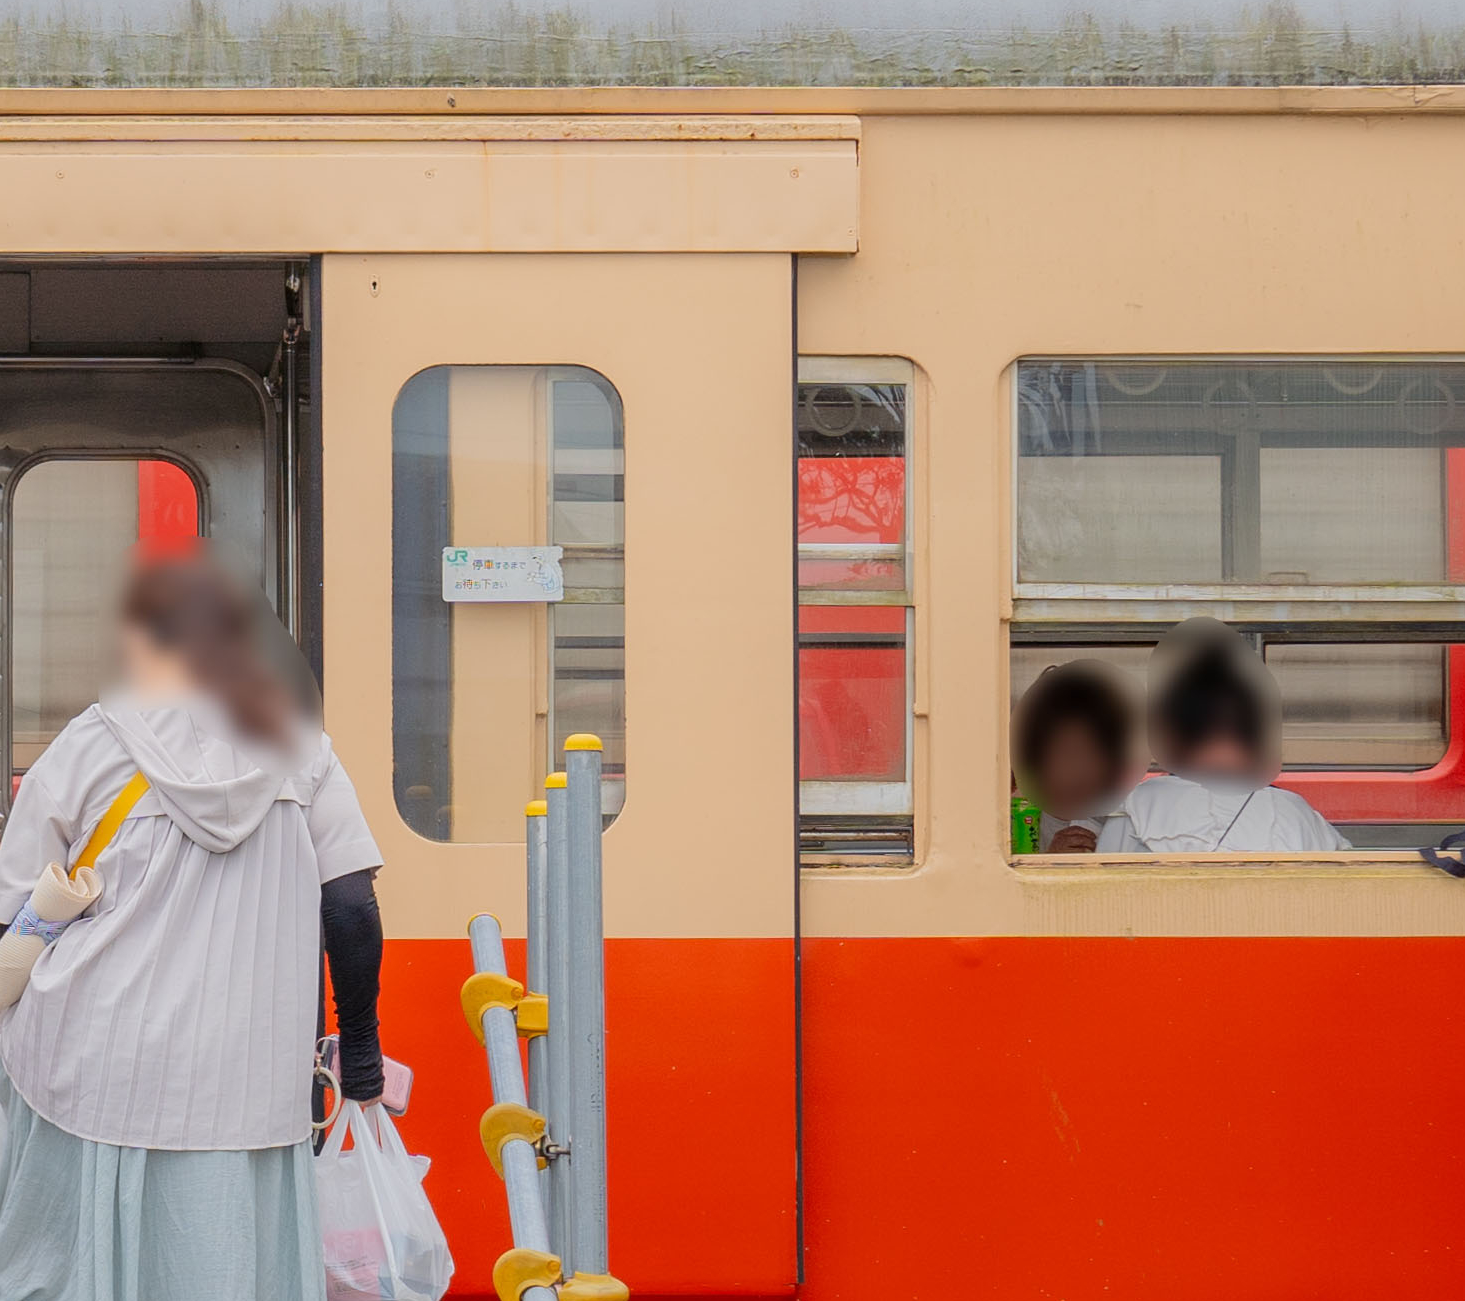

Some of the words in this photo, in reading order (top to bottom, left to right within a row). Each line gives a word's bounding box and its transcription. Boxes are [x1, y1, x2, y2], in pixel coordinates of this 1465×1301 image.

[446, 550, 468, 562] JR
[472, 559, 527, 570] 停車するまで
[454, 578, 509, 590] お待ち下さい
